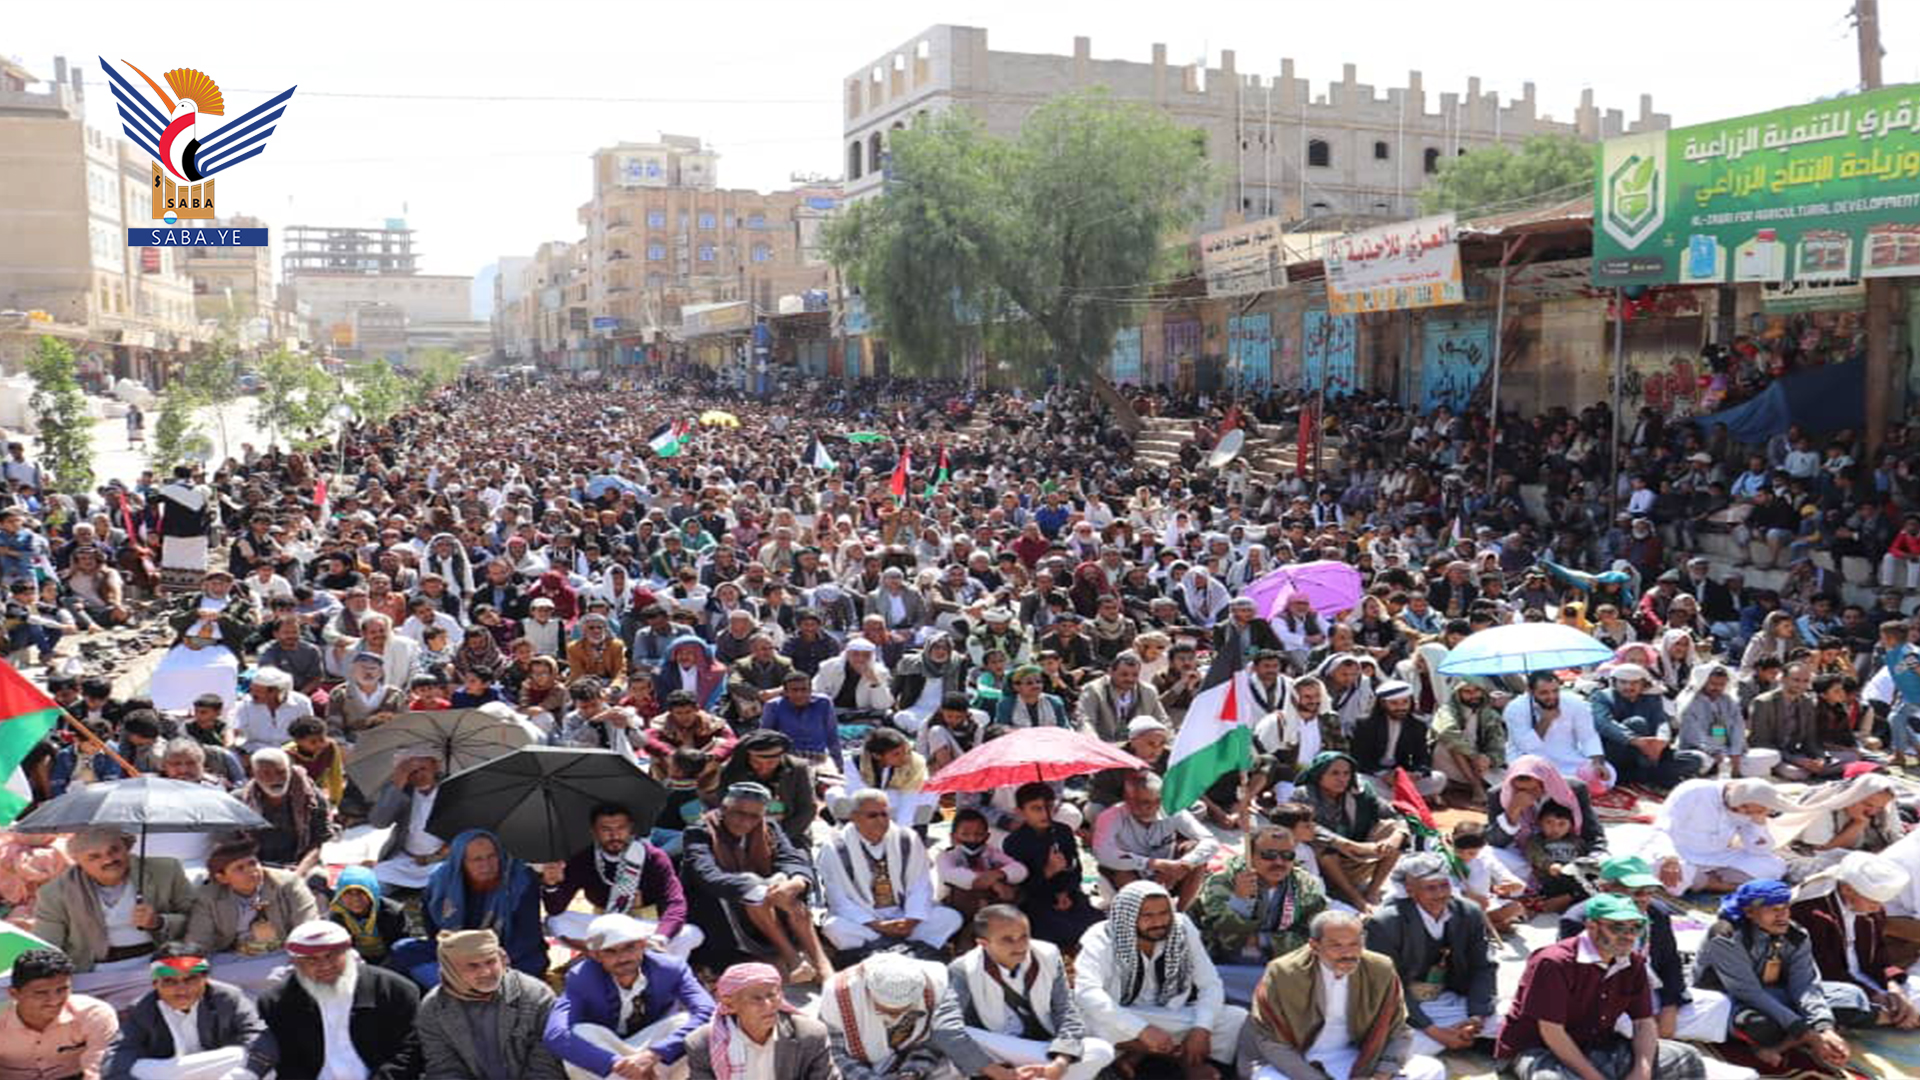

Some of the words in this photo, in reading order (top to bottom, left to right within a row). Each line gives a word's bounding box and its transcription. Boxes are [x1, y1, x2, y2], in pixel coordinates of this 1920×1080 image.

[1684, 126, 1760, 164] الزراعية
[1762, 108, 1851, 152] للتنمية
[1694, 164, 1767, 207] الزراعي
[1832, 194, 1920, 213] DEVELOPMENT
